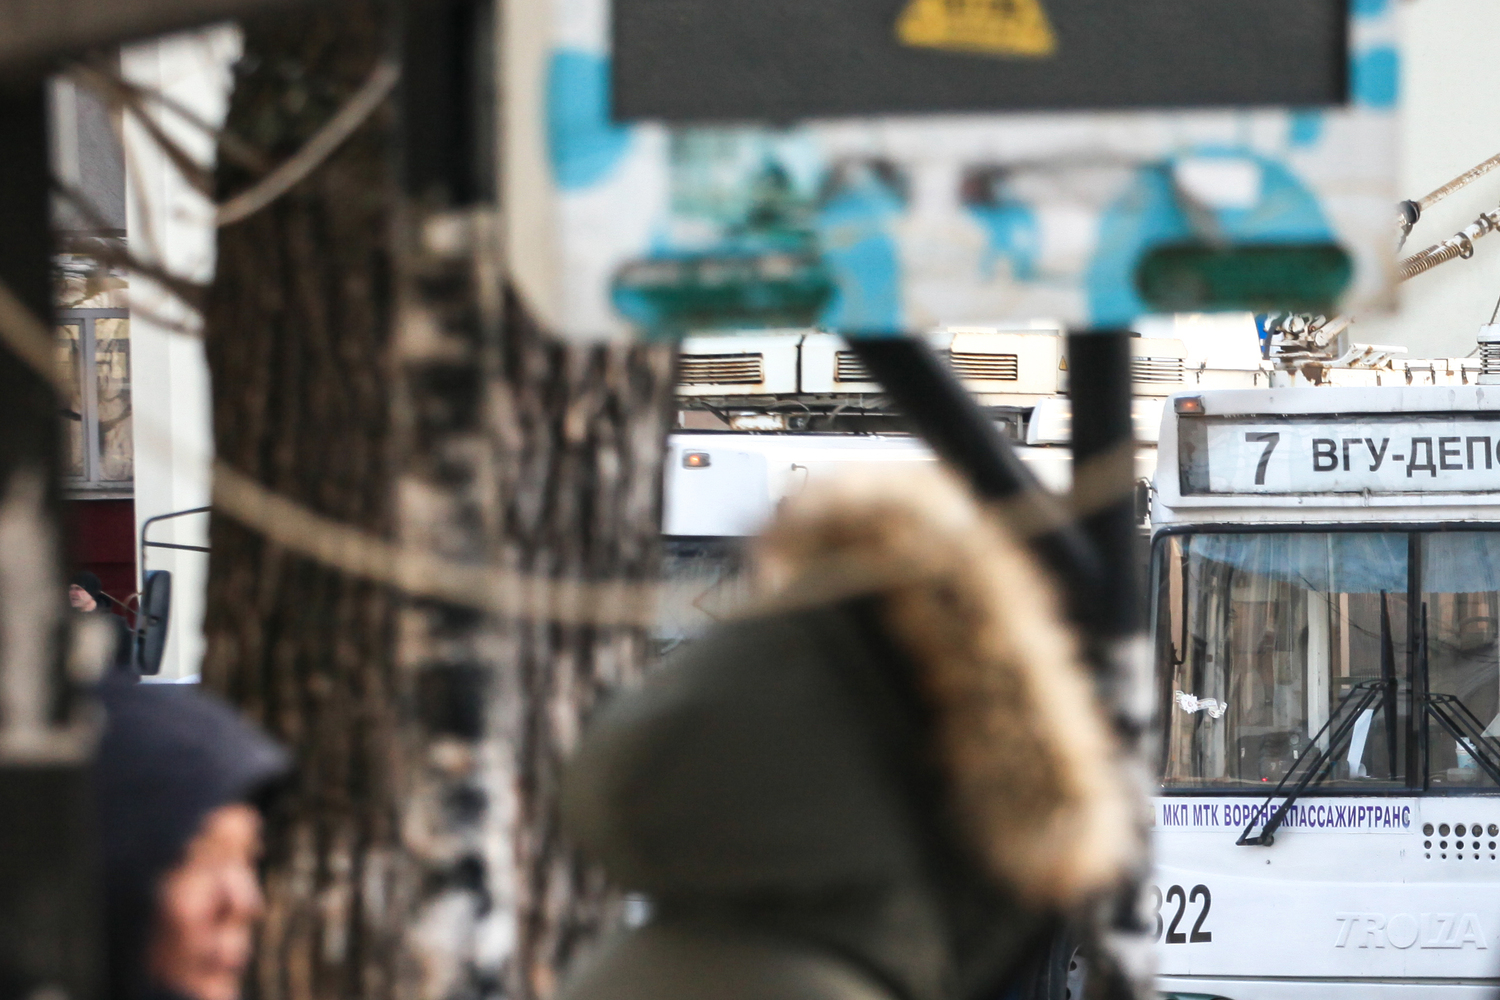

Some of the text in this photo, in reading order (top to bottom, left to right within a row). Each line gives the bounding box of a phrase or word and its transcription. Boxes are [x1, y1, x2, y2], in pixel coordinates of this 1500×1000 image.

[1245, 432, 1280, 486] 7
[1163, 803, 1411, 829] МКП МТК ВОРОНЕПАССАЖИРТРАНС
[1334, 912, 1488, 950] TROLZA
